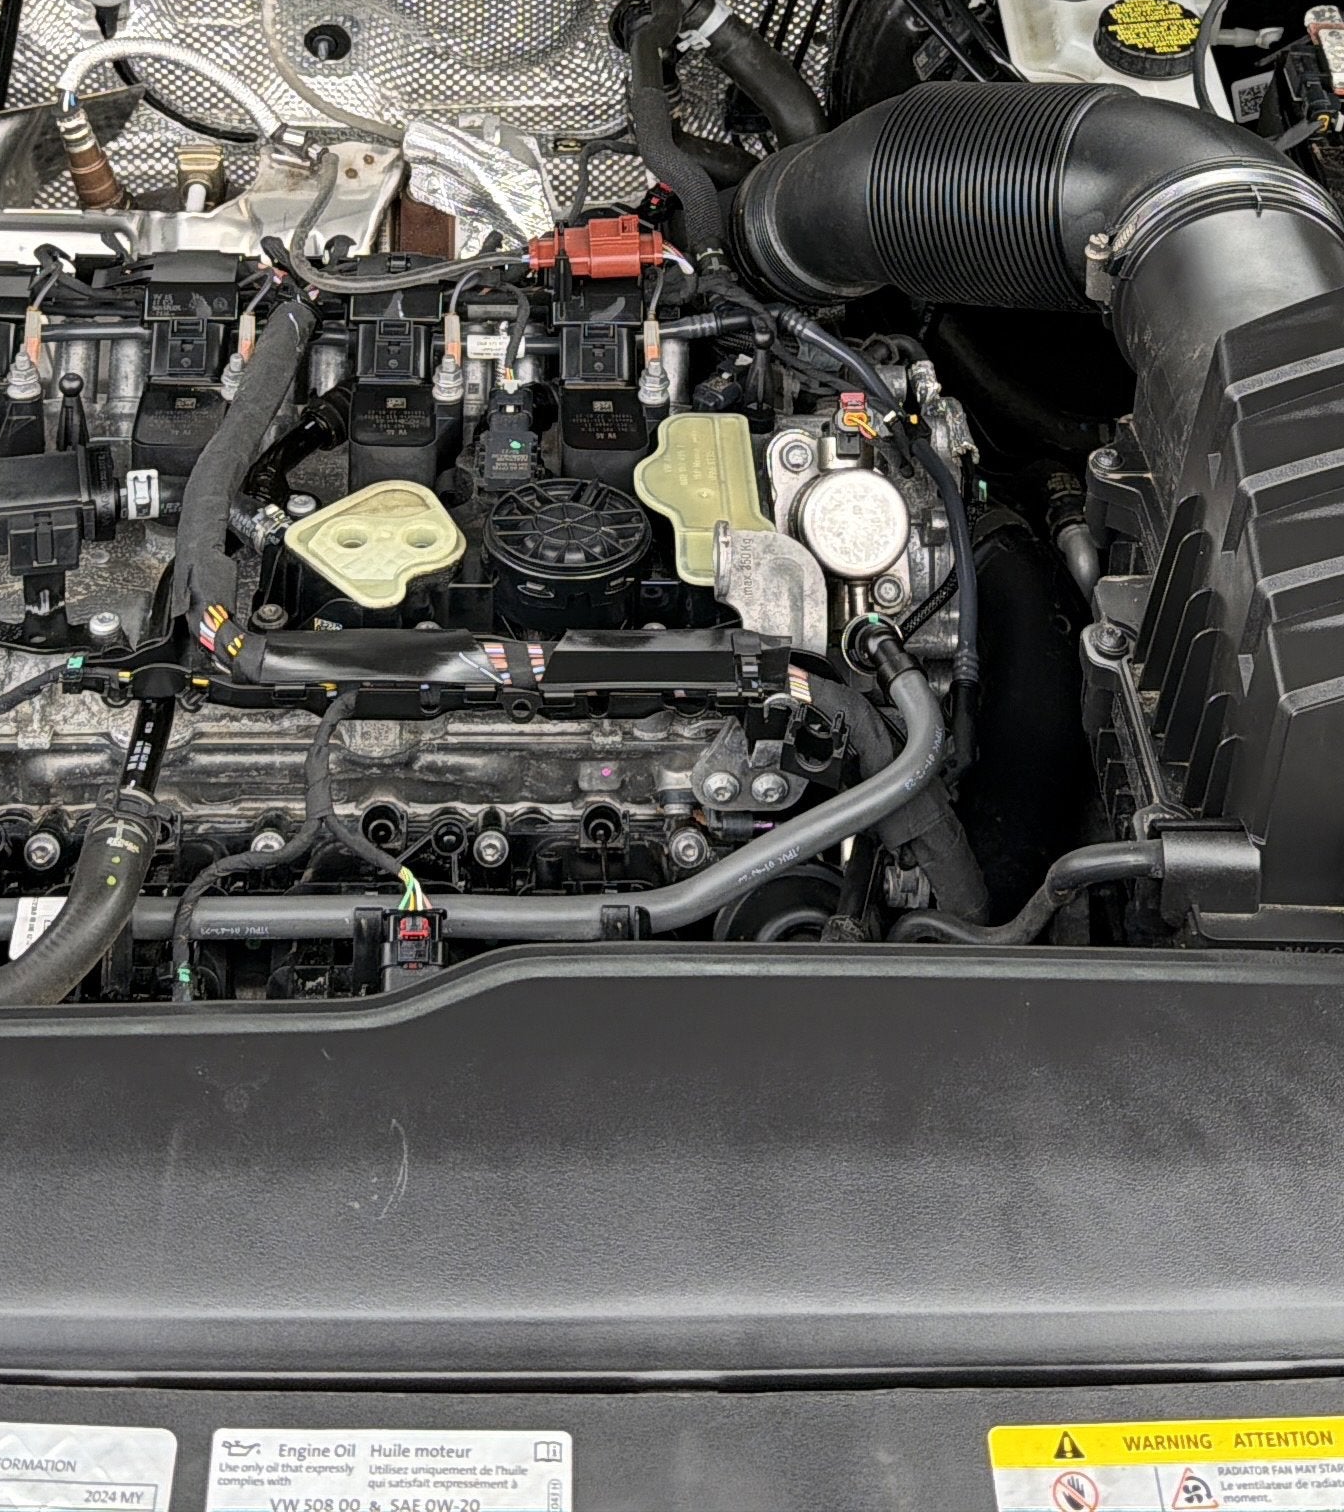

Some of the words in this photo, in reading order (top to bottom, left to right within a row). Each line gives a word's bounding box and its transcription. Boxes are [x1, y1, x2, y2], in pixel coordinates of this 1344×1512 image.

[1122, 1434, 1213, 1451] WARNING
[1233, 1430, 1334, 1448] ATTENTION
[278, 1443, 331, 1461] Engine
[334, 1443, 357, 1458] Oil
[370, 1443, 412, 1458] Huile
[414, 1445, 473, 1459] moteur
[219, 1462, 240, 1473] Use
[241, 1462, 265, 1476] only
[266, 1462, 279, 1473] oil
[281, 1462, 303, 1473] that
[305, 1463, 355, 1476] expressly
[369, 1464, 409, 1475] Utilisez
[411, 1465, 478, 1478] uniquement
[480, 1465, 493, 1476] de
[1217, 1465, 1270, 1476] RADIATOR
[1272, 1465, 1293, 1475] FAN
[1295, 1464, 1317, 1474] MAY
[217, 1476, 265, 1488] complies
[267, 1476, 292, 1486] with
[368, 1479, 386, 1490] qui
[388, 1478, 431, 1489] satisfait
[1220, 1480, 1234, 1491] Le
[1235, 1479, 1292, 1490] ventilateur
[1295, 1478, 1309, 1489] de
[84, 1490, 117, 1504] 2024
[120, 1491, 145, 1505] MY
[1223, 1494, 1273, 1503] moment.
[270, 1498, 301, 1512] VW
[304, 1498, 334, 1512] 508
[338, 1498, 361, 1512] 00
[369, 1500, 381, 1512] &
[390, 1499, 423, 1512] SAE
